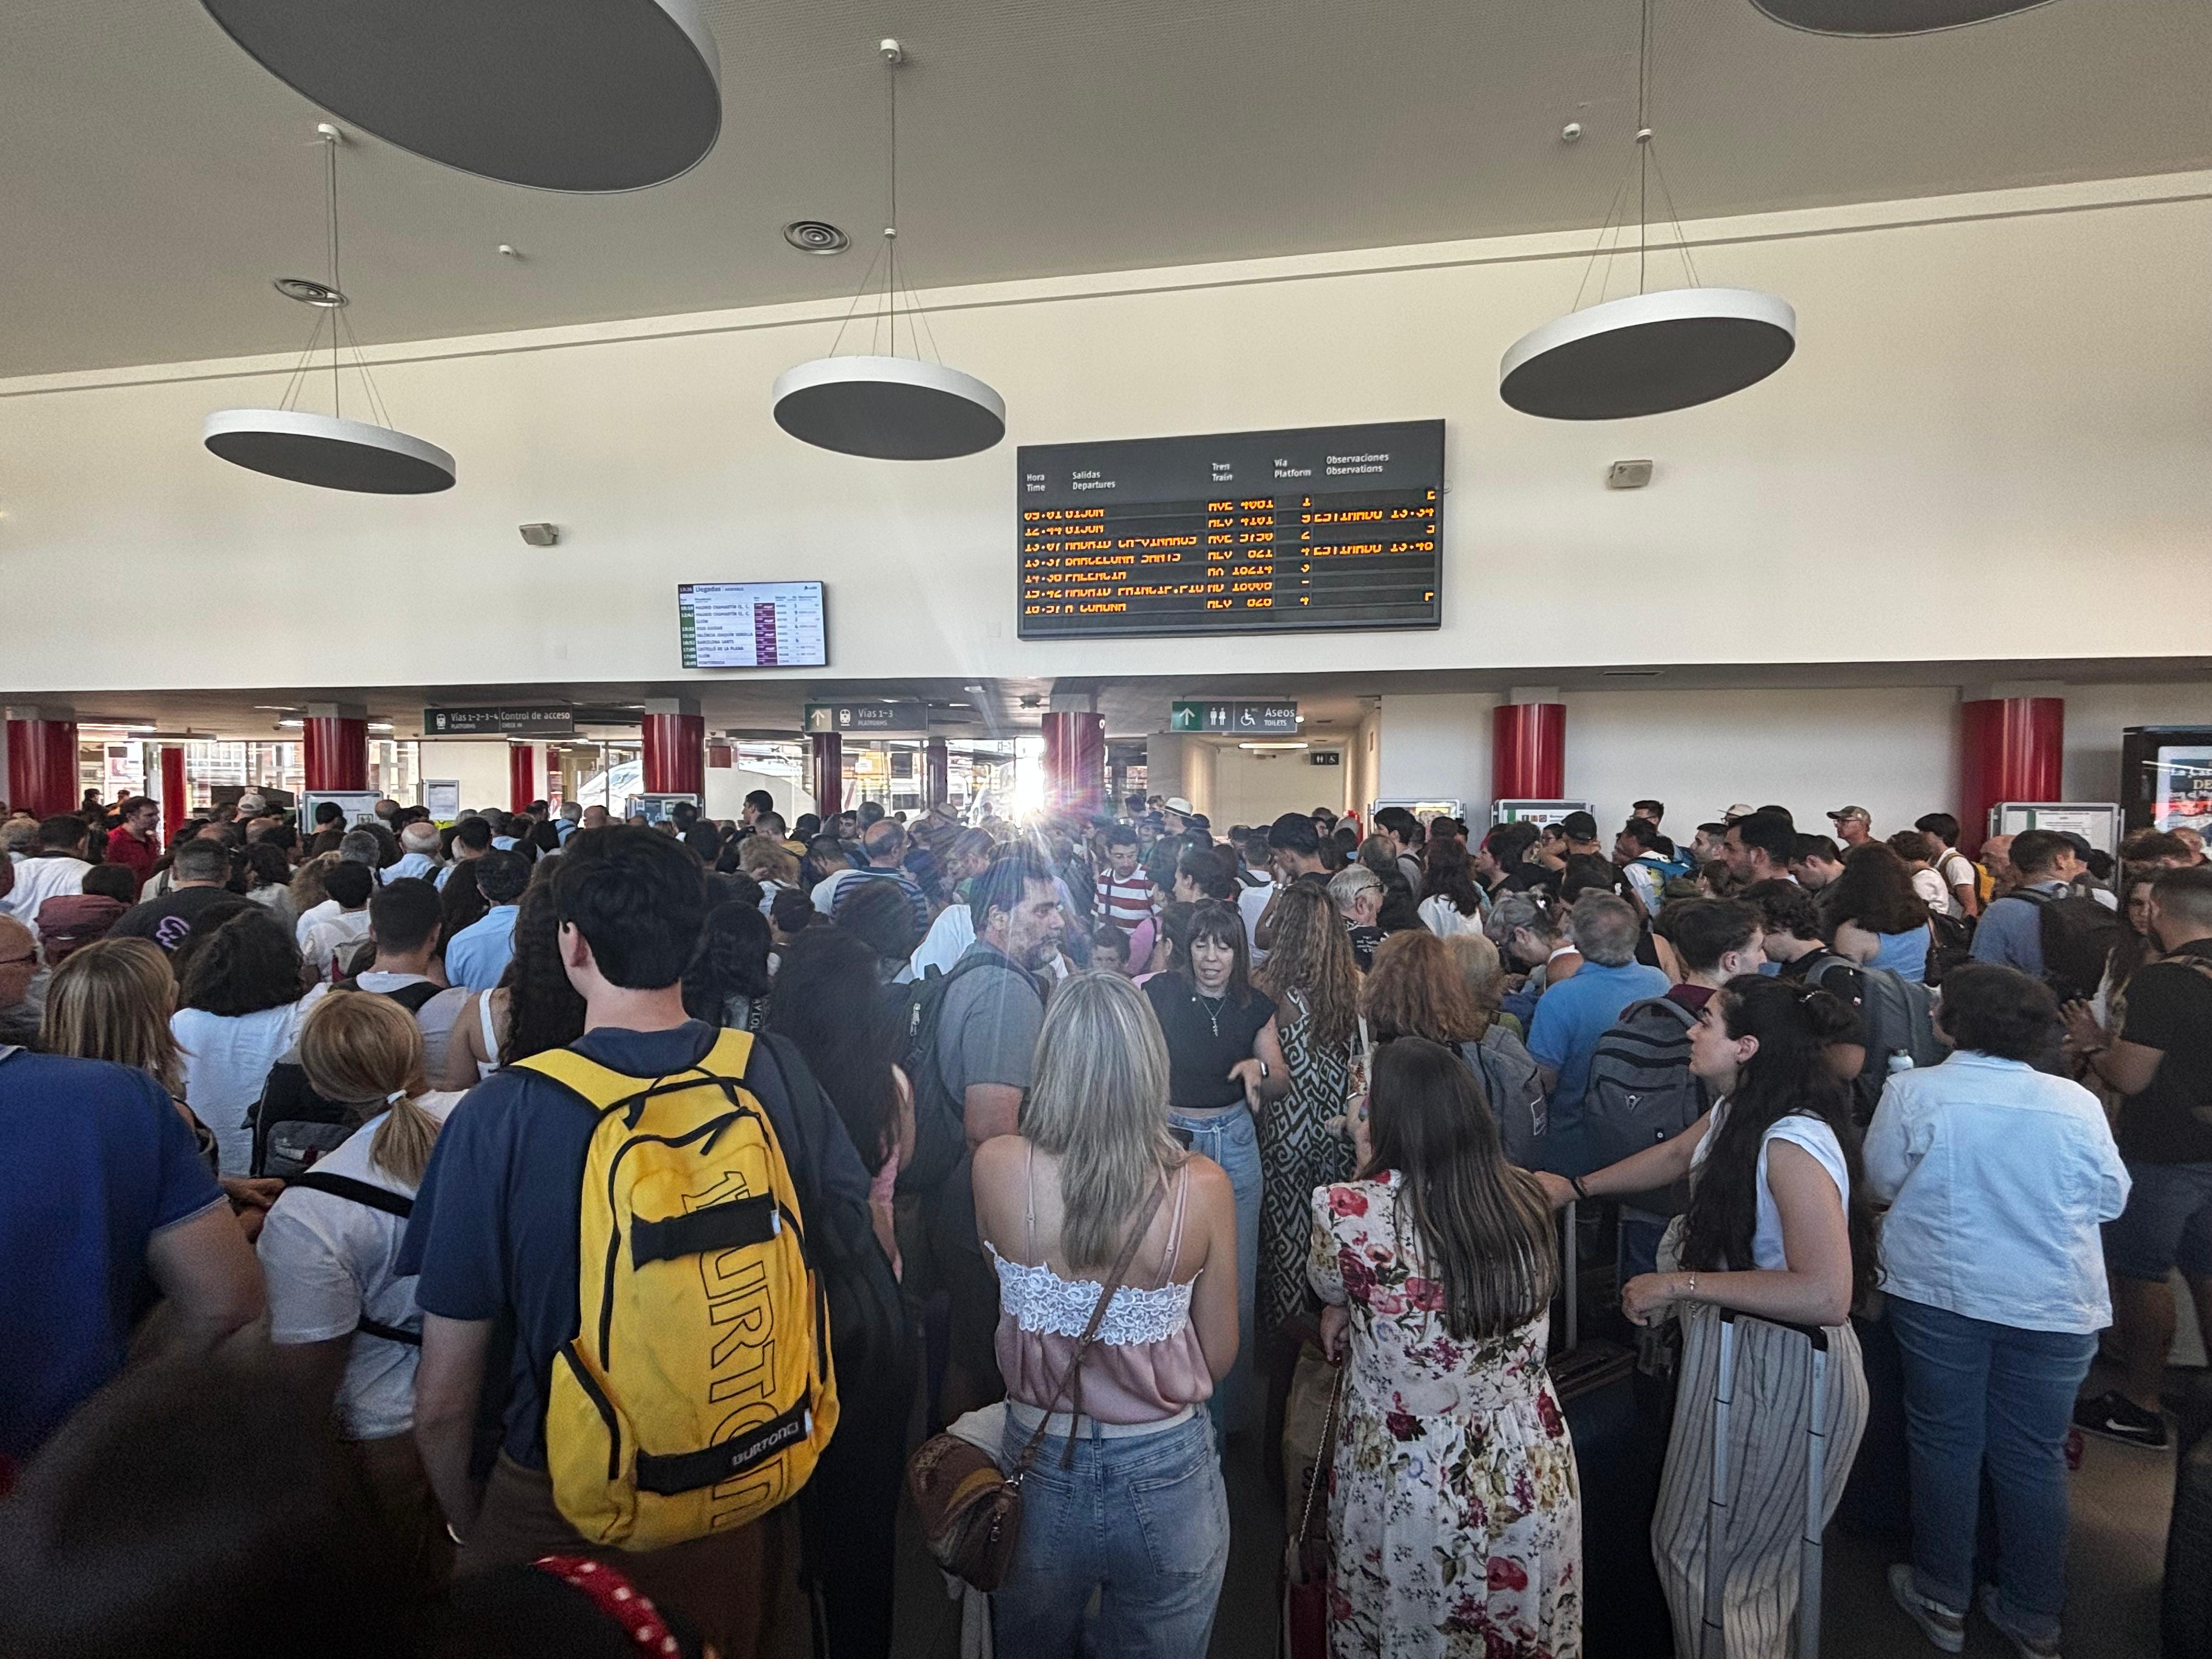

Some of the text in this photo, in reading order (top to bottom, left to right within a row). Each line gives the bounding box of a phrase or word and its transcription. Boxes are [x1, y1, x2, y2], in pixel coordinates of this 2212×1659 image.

[1274, 459, 1288, 467] Vía
[1326, 454, 1389, 464] Observaciones
[1212, 462, 1231, 471] Tren
[1326, 465, 1383, 476] Observations
[1072, 471, 1101, 479] Salidas
[1212, 473, 1233, 482] Train
[1274, 470, 1312, 478] Platform
[1026, 484, 1046, 492] Time
[1072, 481, 1116, 491] Departures
[450, 713, 466, 721] Vías
[501, 711, 529, 721] Control
[544, 712, 570, 720] acceso
[858, 708, 893, 718] Vías 1-3
[1265, 707, 1295, 718] Aseos
